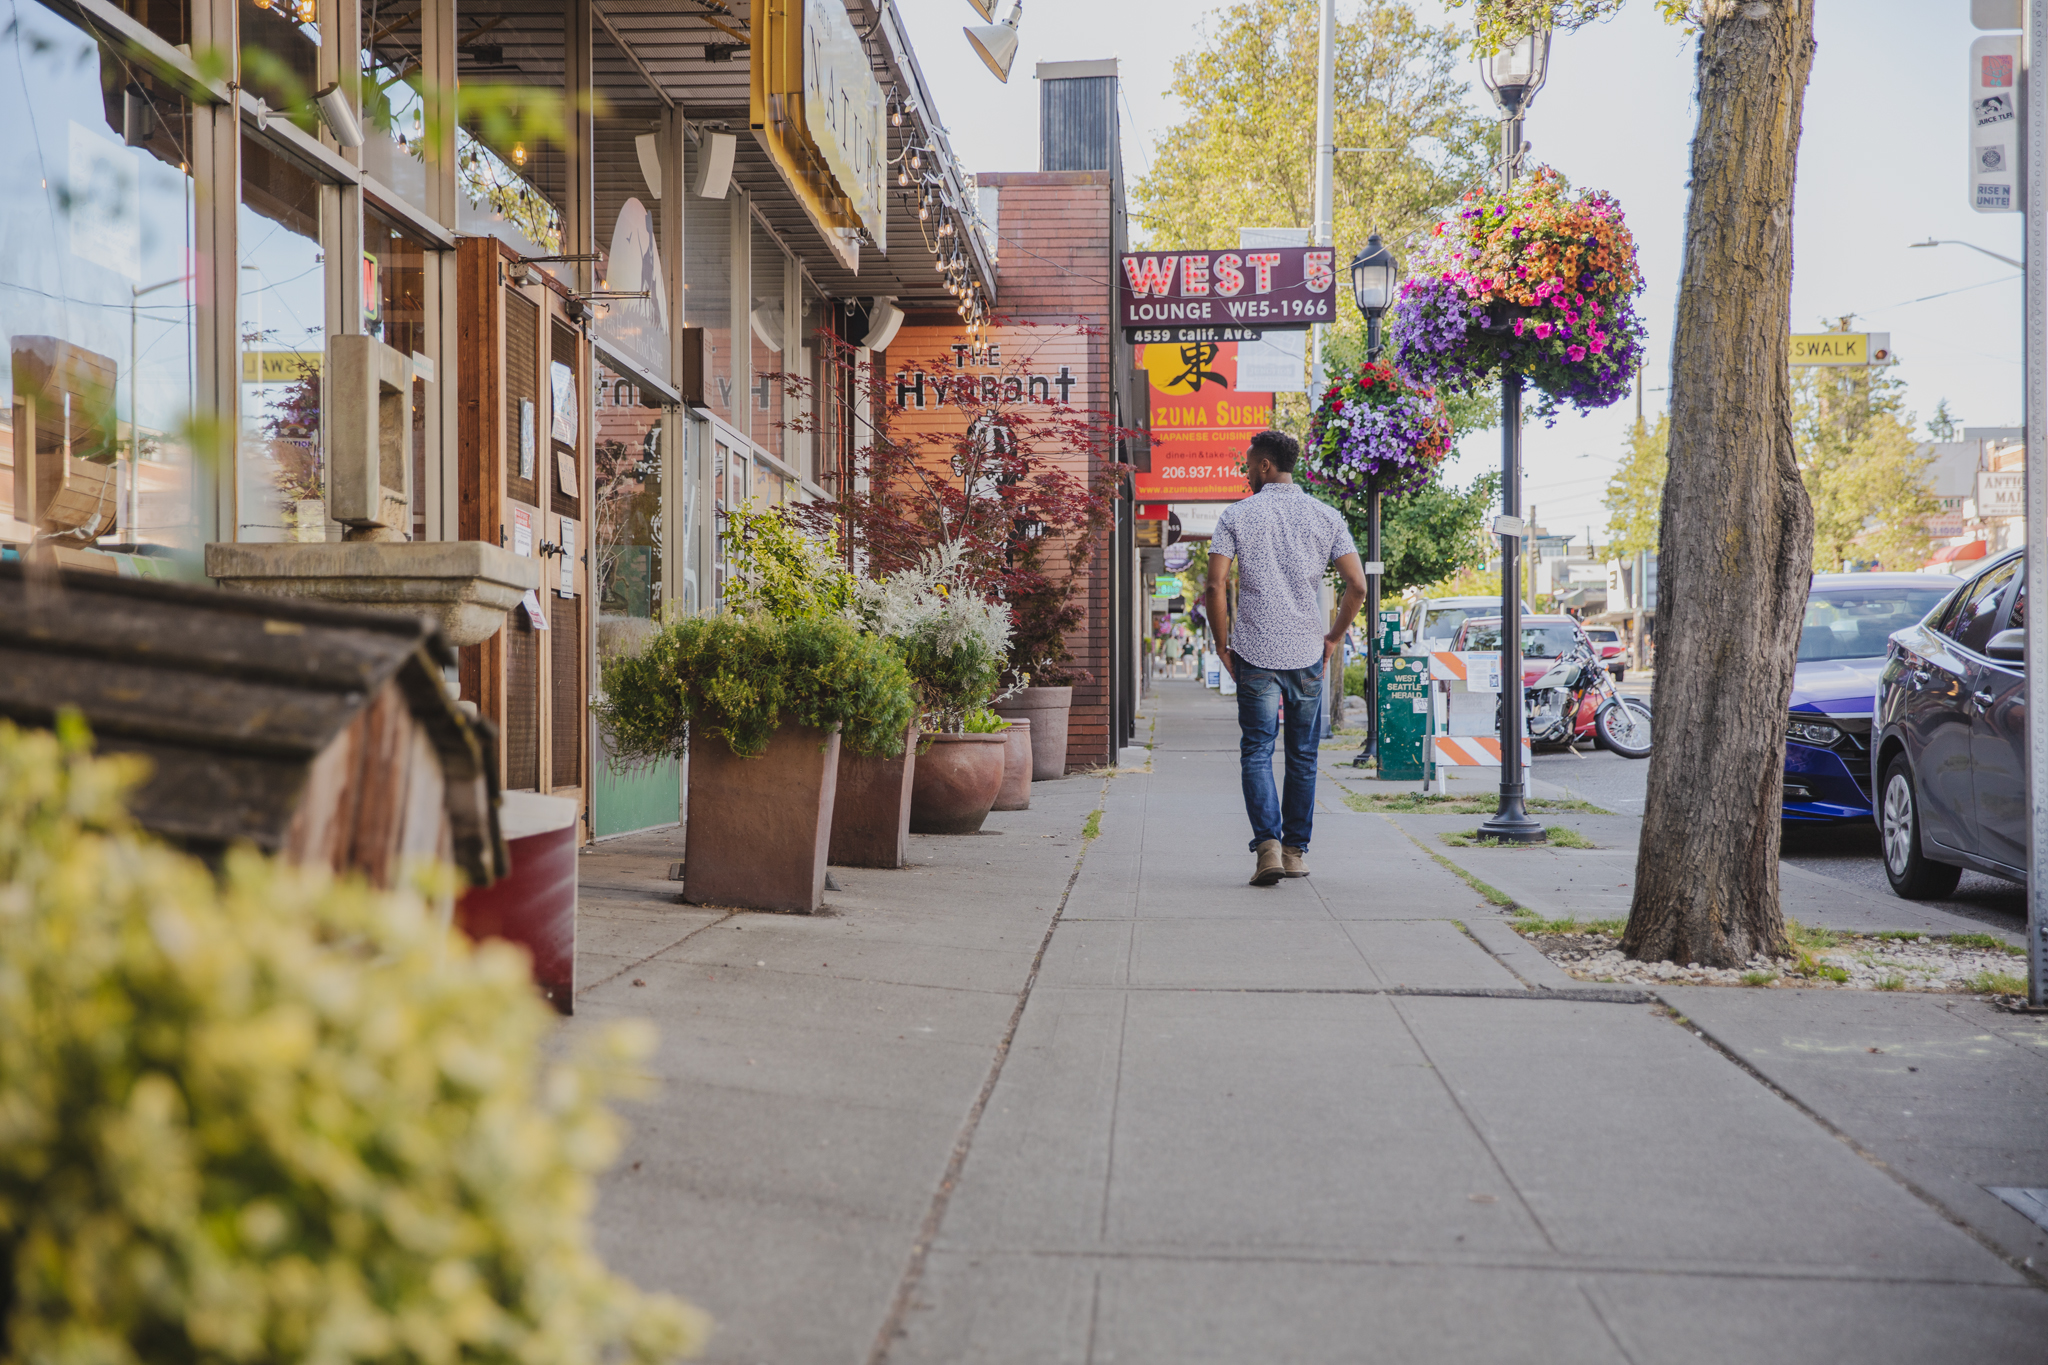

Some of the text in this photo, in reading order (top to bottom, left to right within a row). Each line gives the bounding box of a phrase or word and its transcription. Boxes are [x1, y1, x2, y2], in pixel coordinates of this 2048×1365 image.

[808, 24, 882, 214] NATURE
[1978, 114, 1997, 126] JUICE
[1978, 186, 2010, 195] RISE N
[1977, 196, 2010, 206] UNITE!
[1122, 251, 1333, 299] WEST 5
[1130, 299, 1328, 321] LOUNGE WE5-1966
[1134, 328, 1258, 342] 4539 Calif. Ave.
[951, 343, 1001, 369] THE
[1160, 431, 1253, 441] JAPANESE CUISINE
[1166, 451, 1197, 459] dine-in
[1198, 450, 1204, 459] &
[1387, 683, 1422, 691] SEATTLE
[1391, 691, 1422, 699] HERALD
